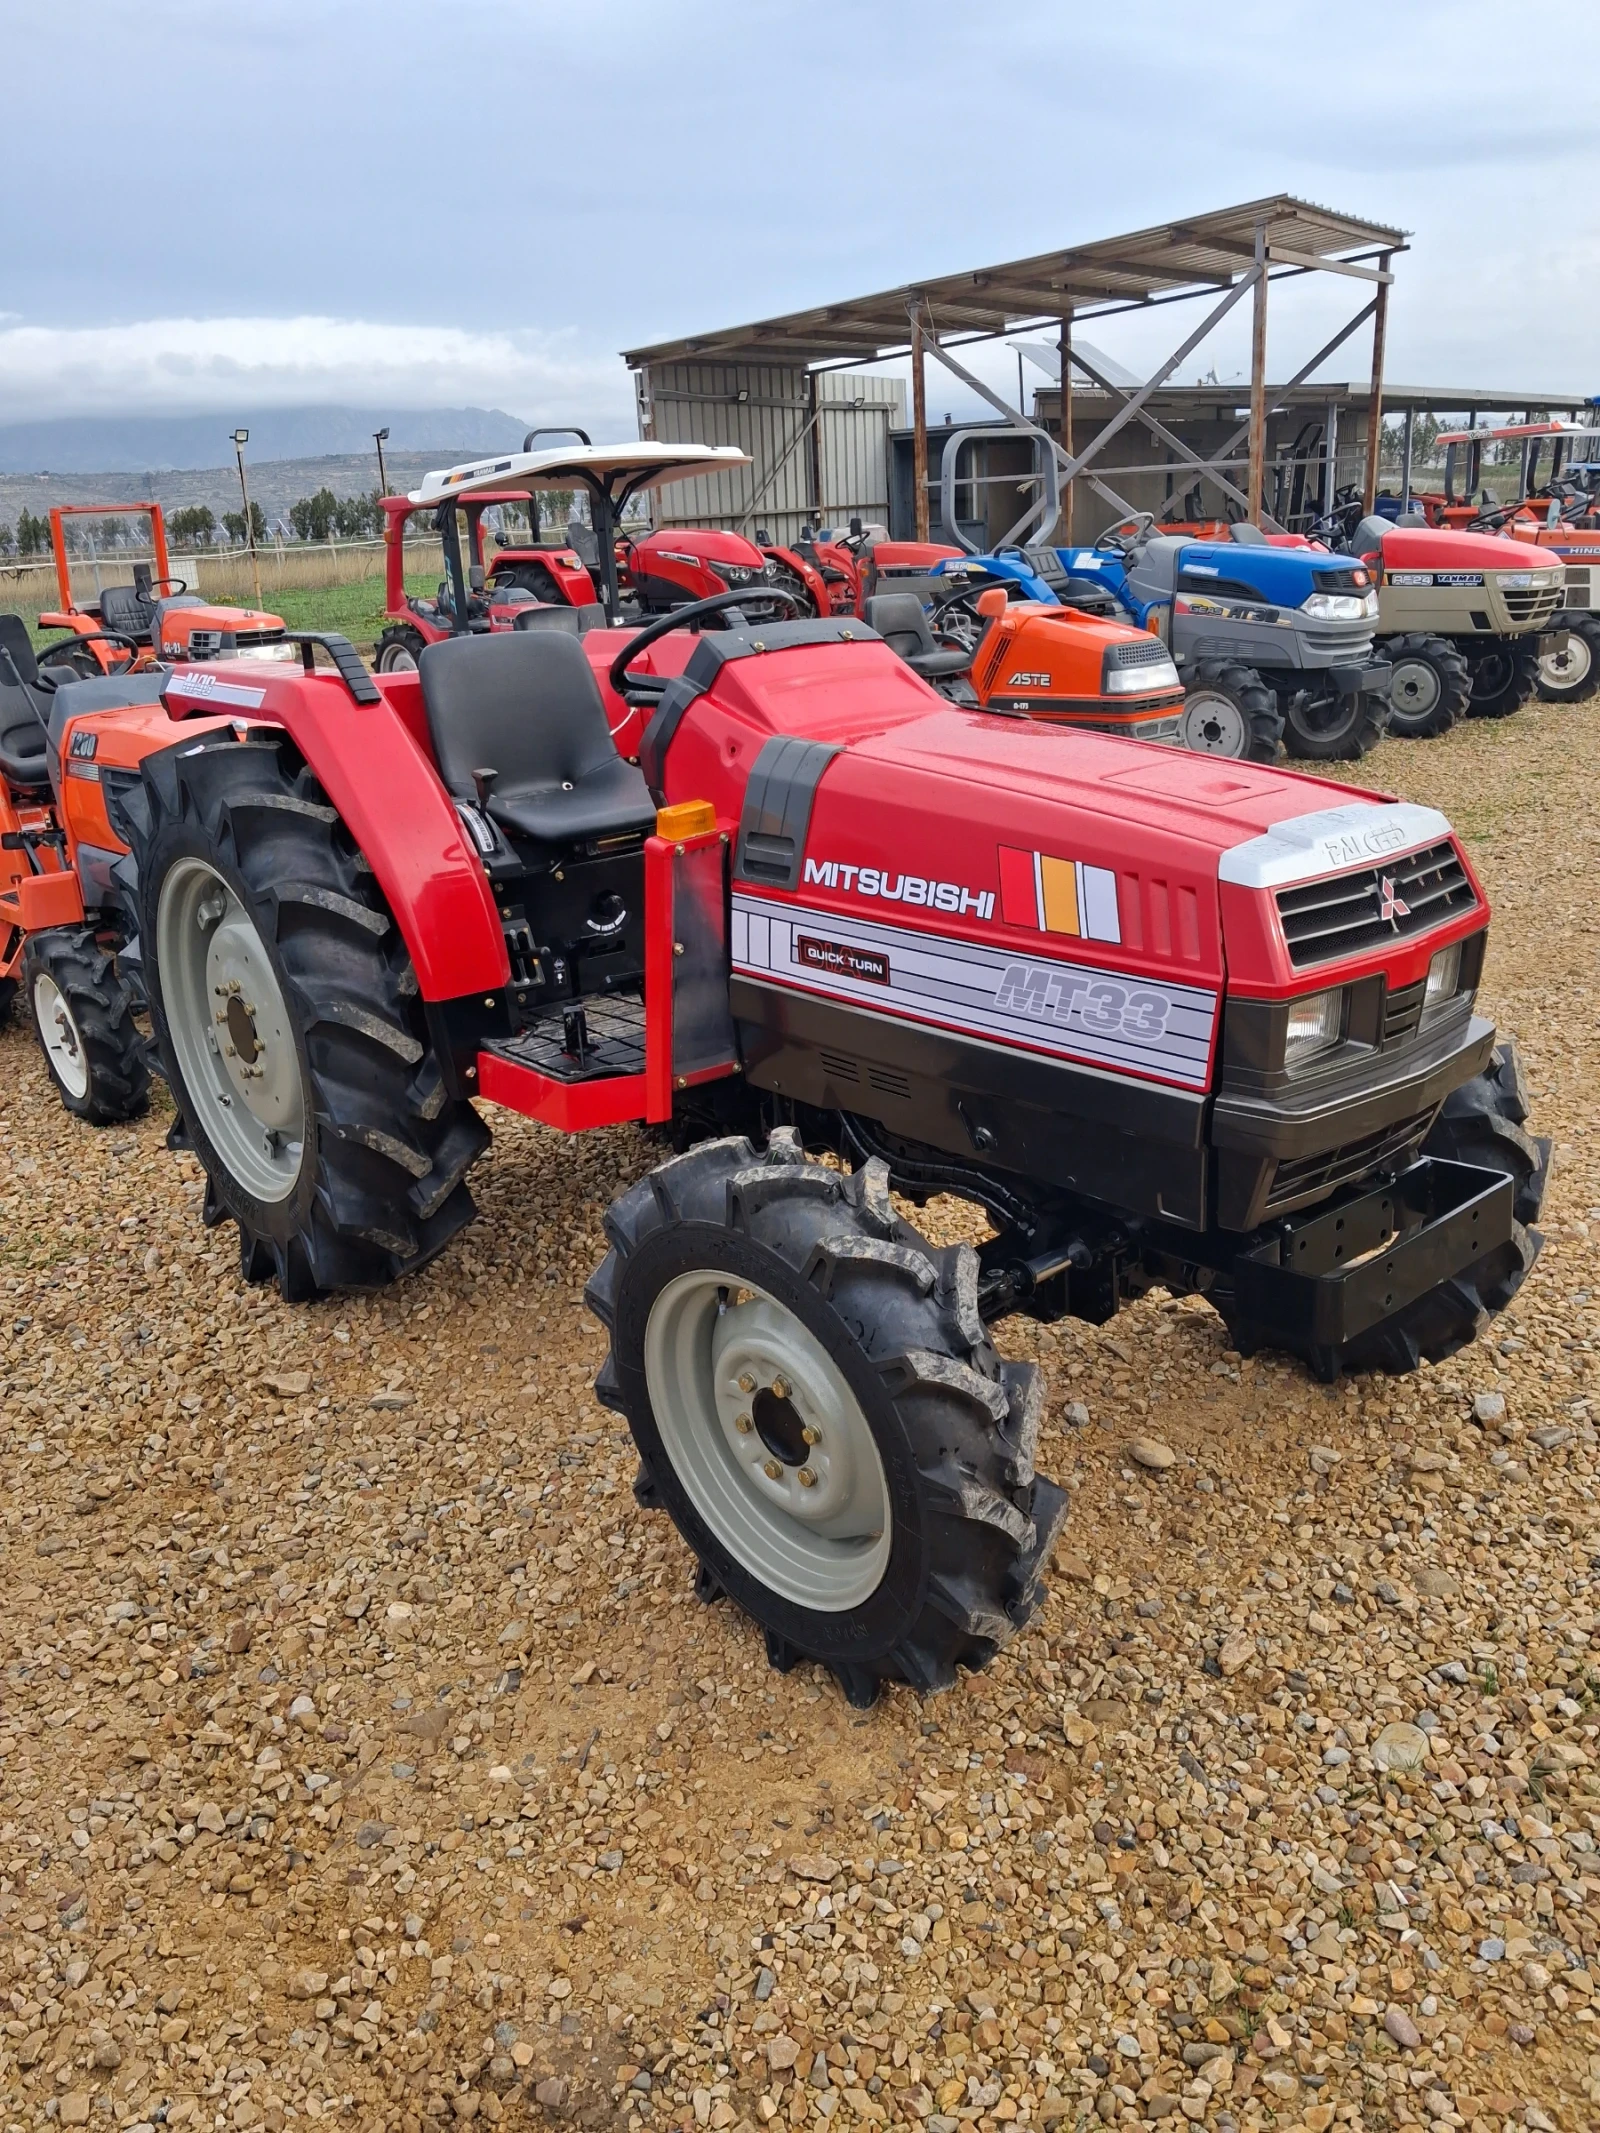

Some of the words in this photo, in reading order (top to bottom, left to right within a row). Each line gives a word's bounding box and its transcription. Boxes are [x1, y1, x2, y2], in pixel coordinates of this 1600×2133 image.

[474, 466, 496, 477] YANMAR
[1283, 457, 1293, 489] SSAN
[1007, 672, 1051, 687] ASTE
[803, 857, 997, 920] MITSUBISHI
[807, 947, 844, 965] QUICK
[847, 956, 883, 975] TURN
[993, 963, 1172, 1043] MT33
